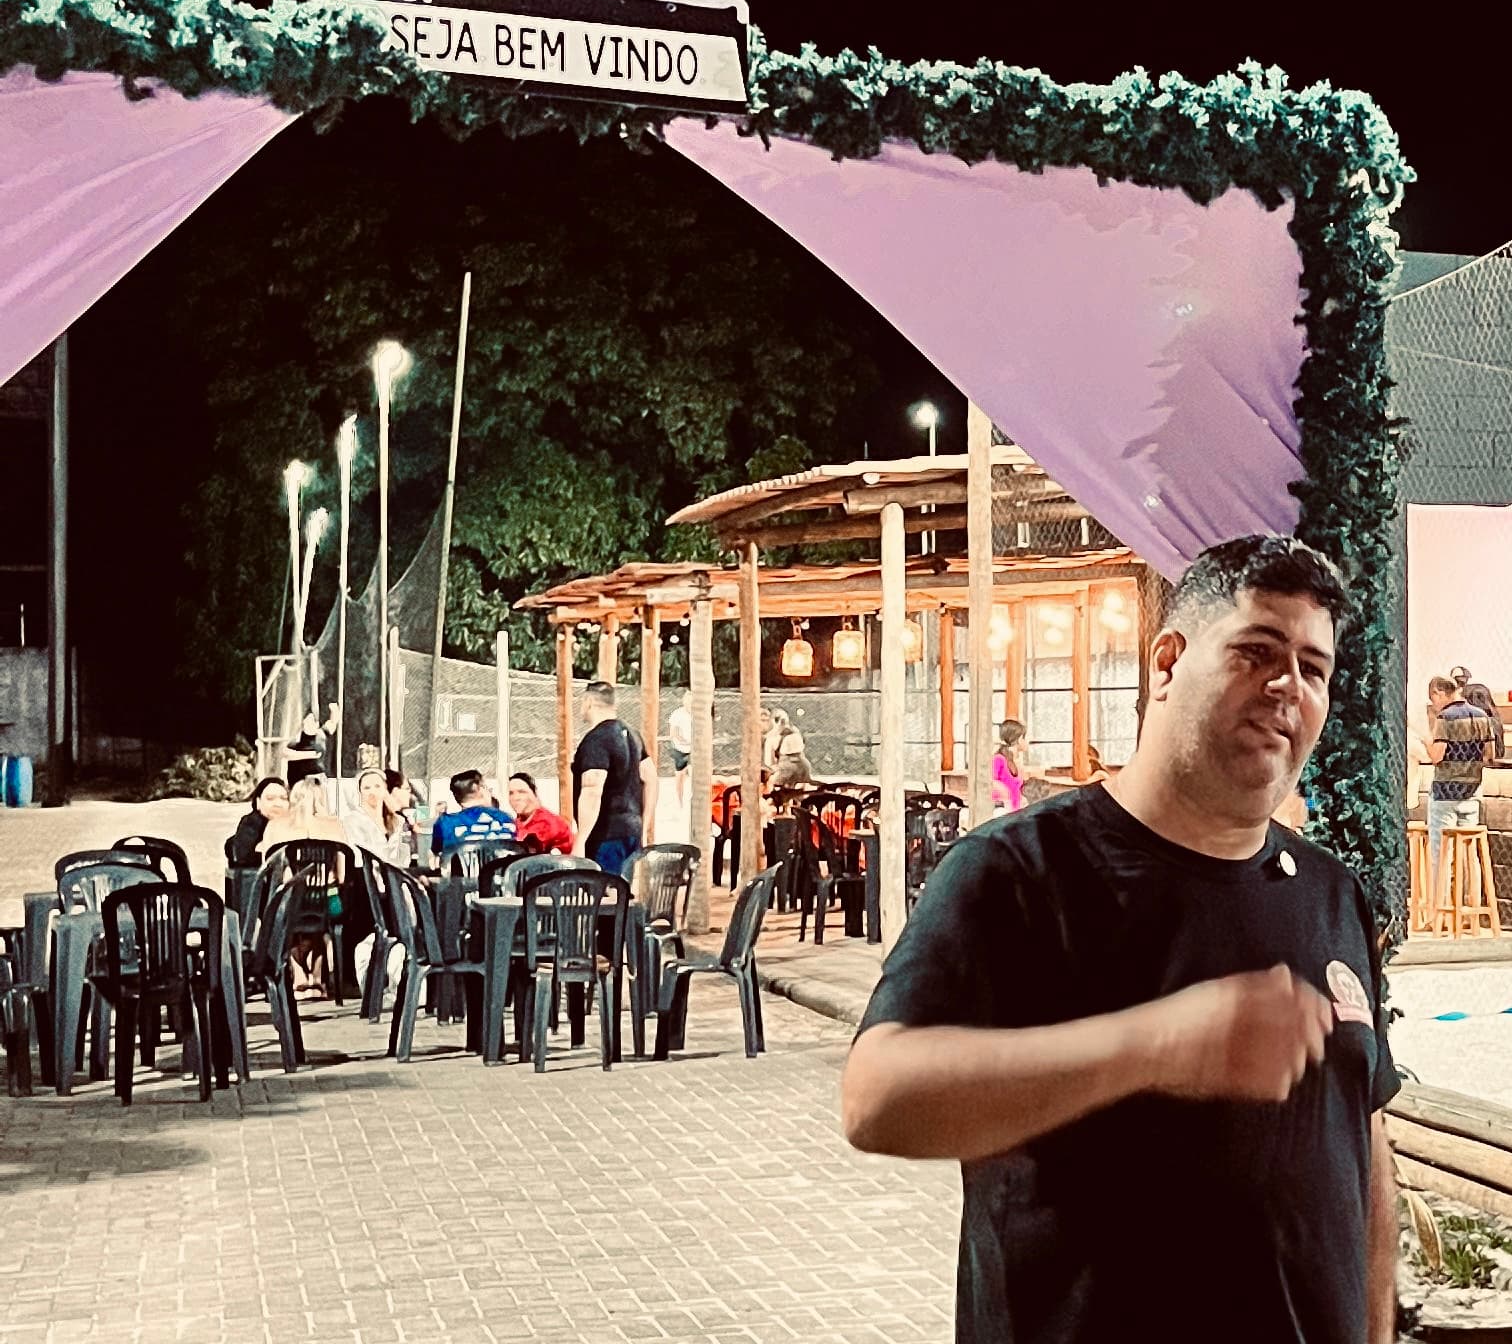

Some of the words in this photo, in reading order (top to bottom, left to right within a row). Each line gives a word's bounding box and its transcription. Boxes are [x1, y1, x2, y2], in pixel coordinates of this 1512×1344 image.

[391, 15, 478, 63] SEJA
[495, 24, 566, 73] BEM
[584, 33, 699, 86] VINDO
